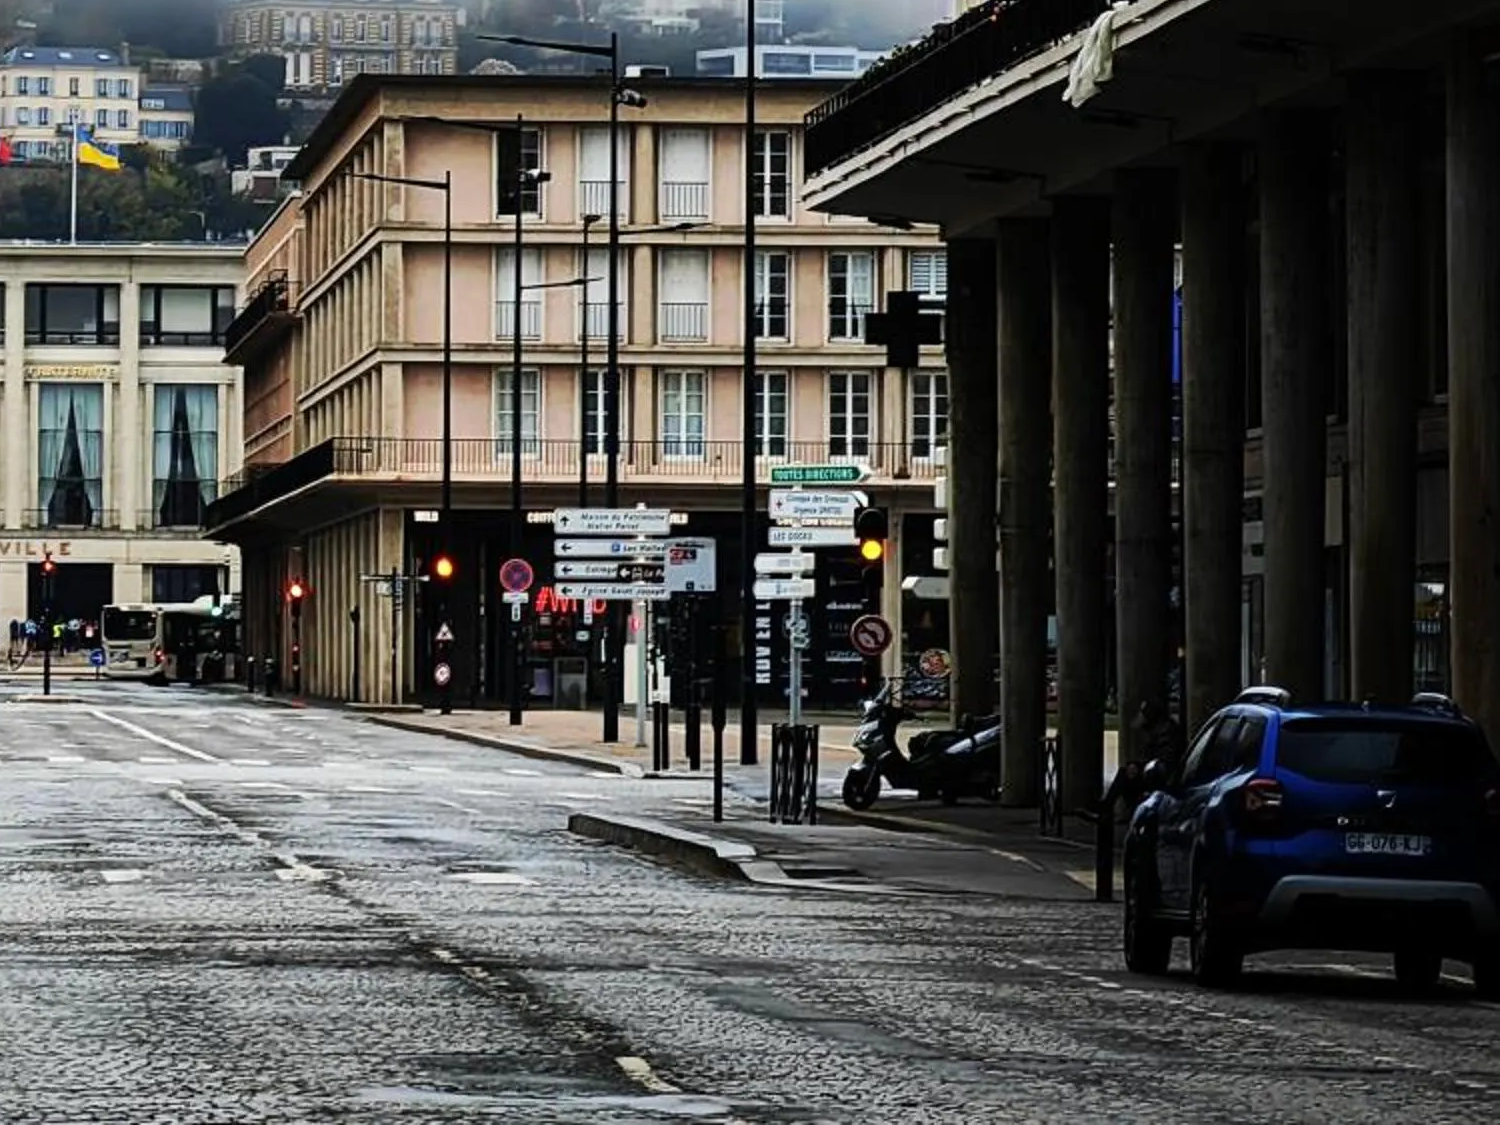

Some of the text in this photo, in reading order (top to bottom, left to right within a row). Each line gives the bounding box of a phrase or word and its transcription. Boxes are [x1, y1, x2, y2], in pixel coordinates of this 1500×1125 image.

[773, 468, 853, 480] TOUTES DIRECTIONS
[581, 512, 665, 521] Maison du Patrimoine
